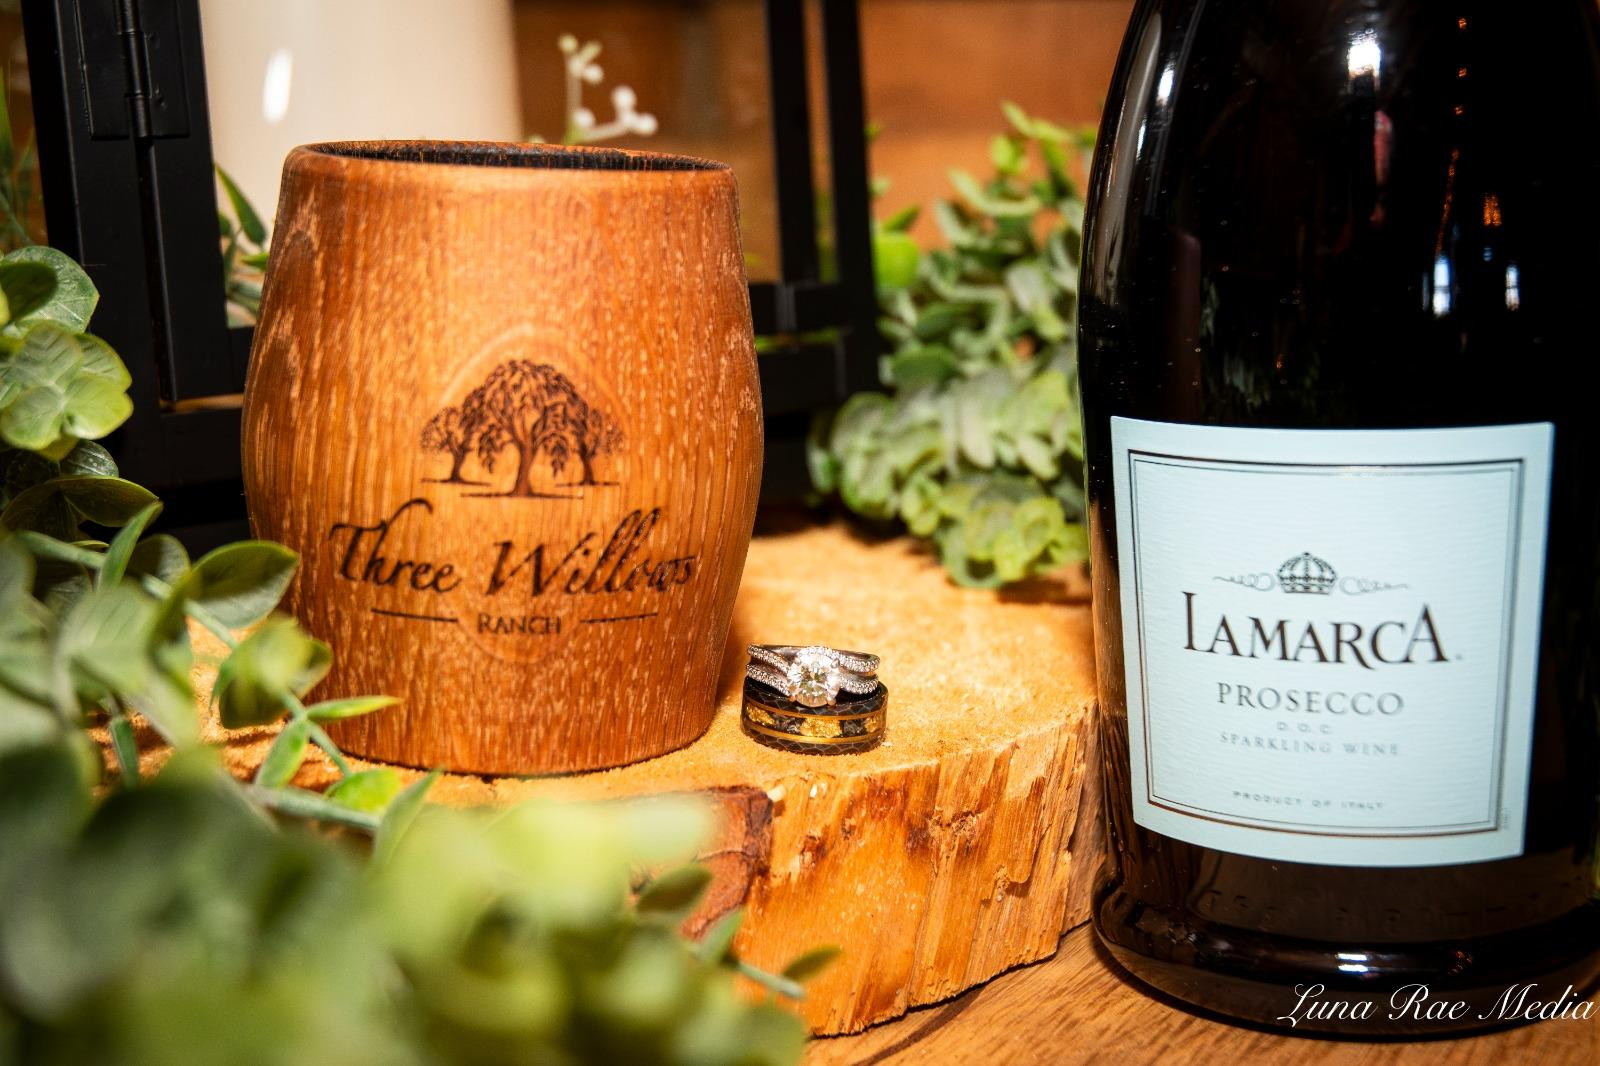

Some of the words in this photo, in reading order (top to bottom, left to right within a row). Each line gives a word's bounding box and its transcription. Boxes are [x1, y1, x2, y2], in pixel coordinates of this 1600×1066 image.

[329, 498, 463, 593] Three
[486, 507, 697, 597] Willows
[477, 612, 562, 635] RANCH
[1216, 681, 1405, 716] PROSECCO
[1219, 731, 1332, 754] SPARKLING
[1342, 742, 1399, 756] WINE
[1232, 790, 1302, 806] PRODUCT
[1311, 799, 1331, 809] OF
